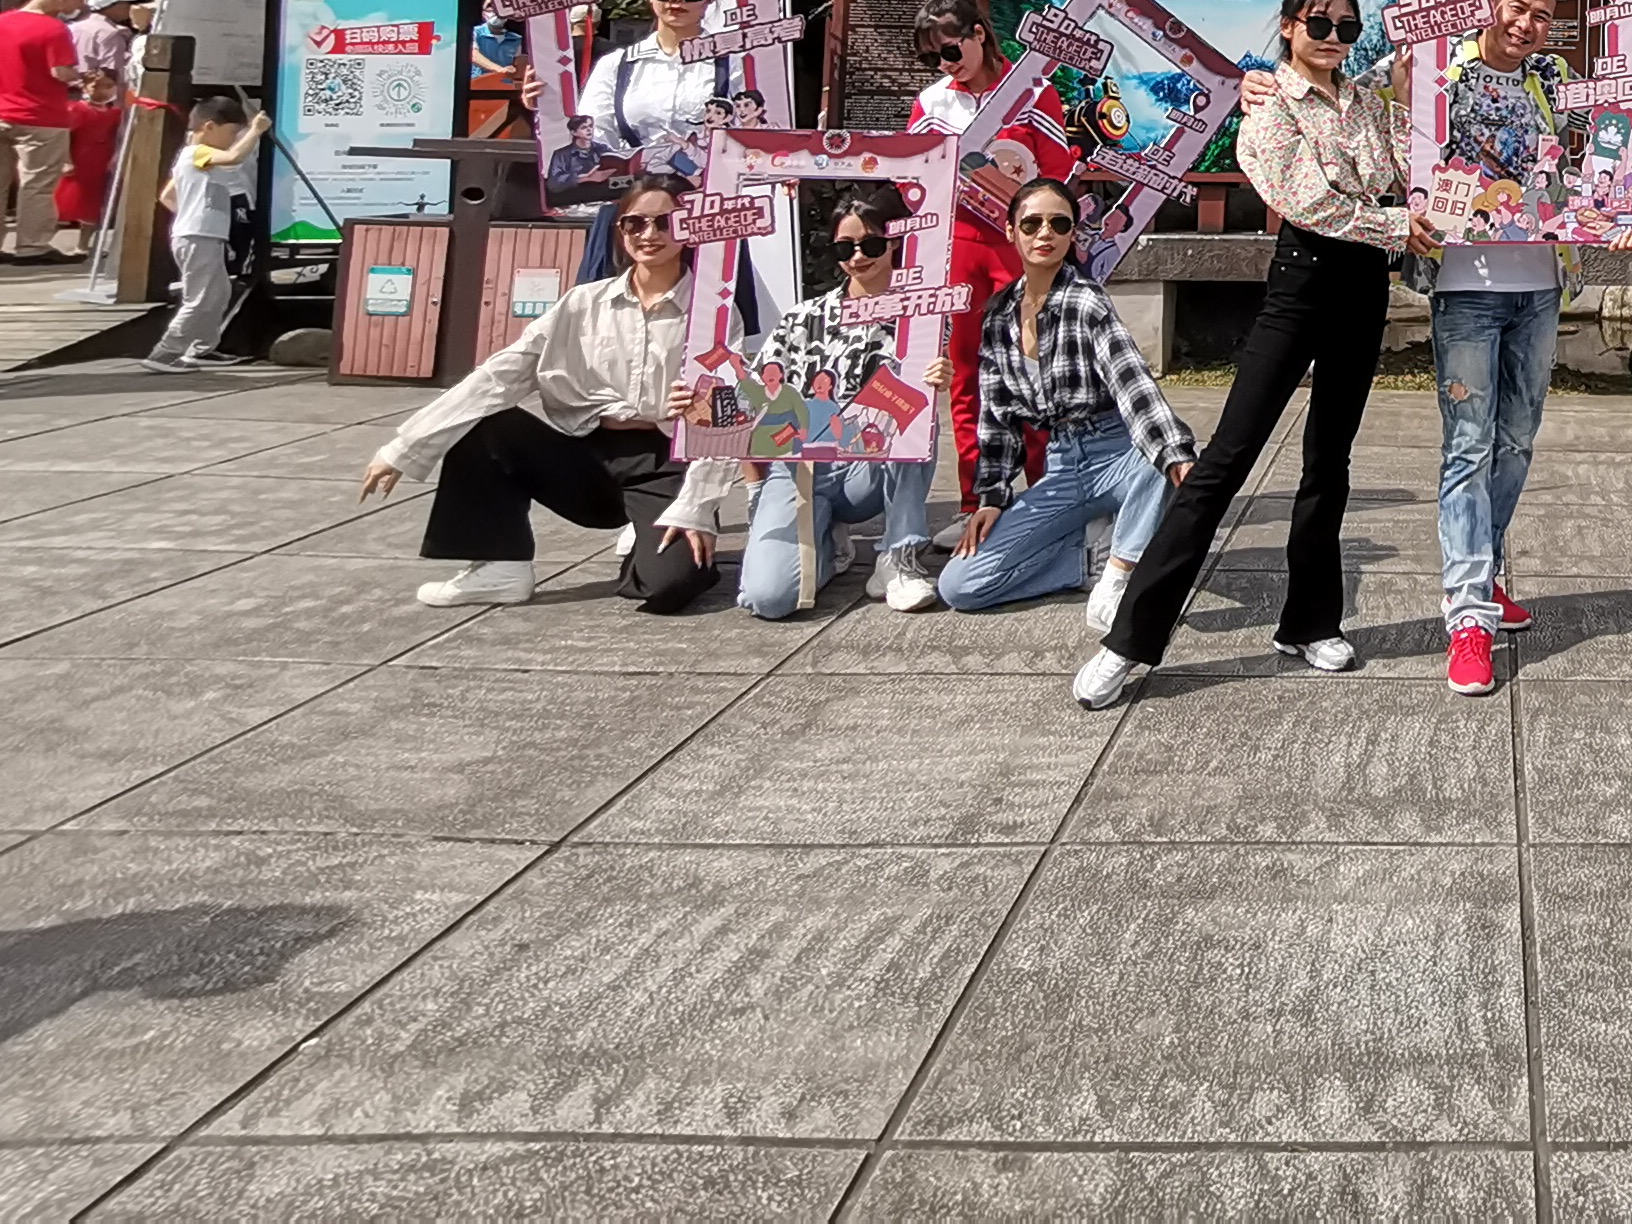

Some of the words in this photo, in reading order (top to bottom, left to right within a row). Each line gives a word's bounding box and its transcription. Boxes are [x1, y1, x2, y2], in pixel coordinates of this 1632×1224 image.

[725, 4, 758, 26] DE
[1400, 11, 1428, 32] THE
[1428, 4, 1458, 27] AGE
[344, 23, 419, 44] 扫码购票
[681, 16, 803, 64] 恢复高考
[1035, 25, 1060, 48] THE
[1056, 35, 1082, 56] AGE
[1595, 55, 1628, 76] DE
[1167, 108, 1208, 133] 明月山
[1145, 143, 1176, 166] DE
[1435, 177, 1471, 197] 澳门
[1432, 195, 1467, 217] 回归
[687, 216, 713, 233] THE
[713, 212, 740, 230] AGE
[739, 209, 759, 225] OF
[888, 214, 939, 235] 明月山
[890, 267, 924, 288] DE
[841, 285, 970, 325] 改革开放
